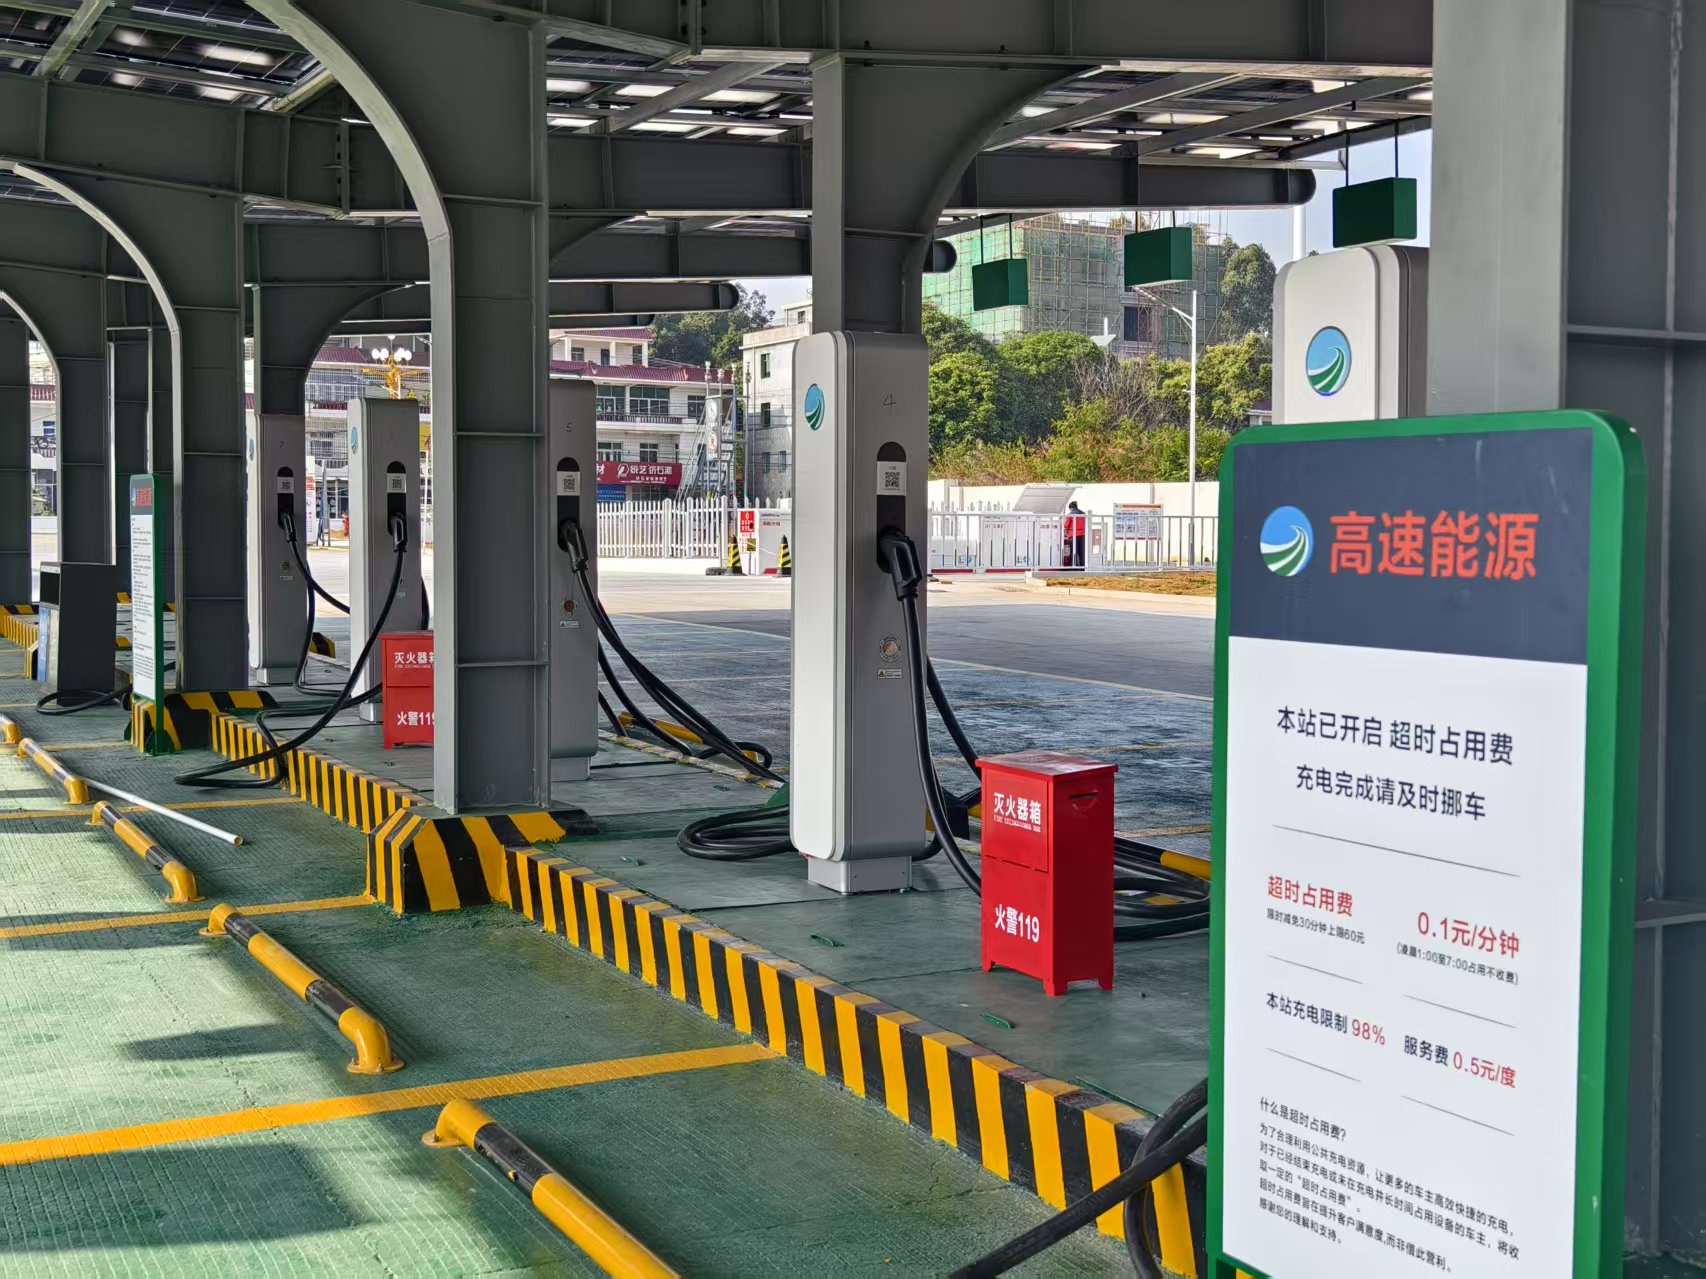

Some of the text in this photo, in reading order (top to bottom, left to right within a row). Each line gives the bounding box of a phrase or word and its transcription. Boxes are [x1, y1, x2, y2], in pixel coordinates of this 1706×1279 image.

[1329, 509, 1539, 580] 高速能源
[1277, 705, 1514, 766] 本站已开启 超时占用费
[993, 791, 1041, 826] 灭火器箱
[1296, 764, 1486, 820] 充电完成请及时挪车
[994, 903, 1040, 943] 火警119
[1267, 874, 1354, 918] 超时占用费
[1417, 911, 1520, 960] 0.1元/分钟
[1265, 991, 1386, 1046] 本站充电限制 98%
[1403, 1034, 1517, 1089] 服务费 0.5元/度
